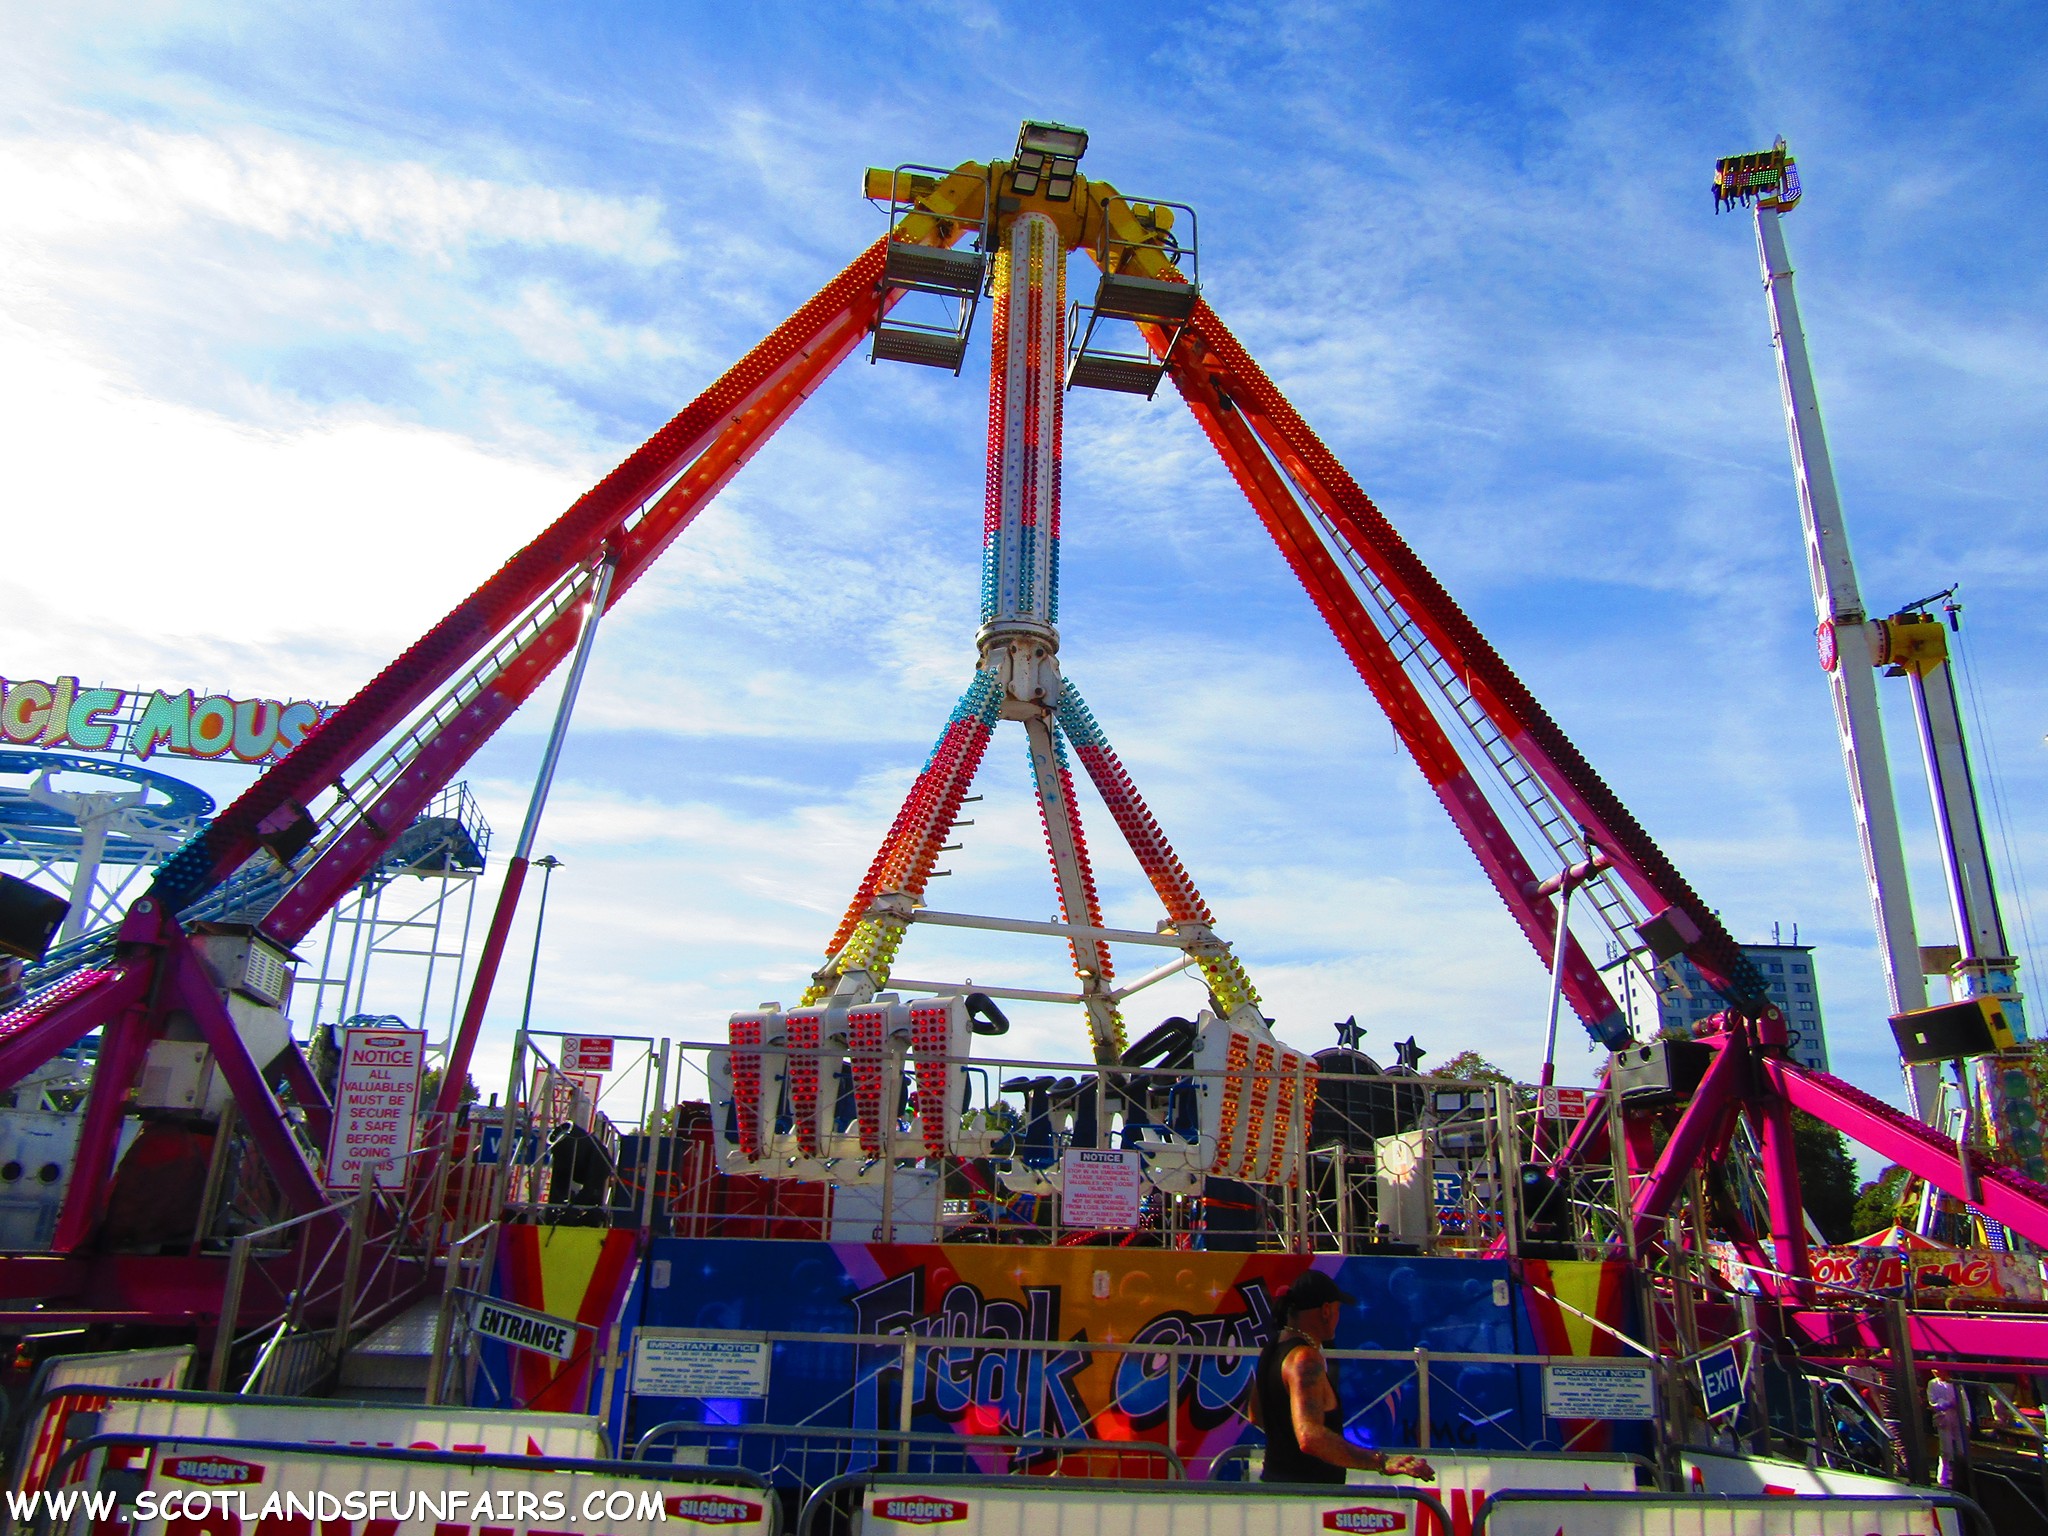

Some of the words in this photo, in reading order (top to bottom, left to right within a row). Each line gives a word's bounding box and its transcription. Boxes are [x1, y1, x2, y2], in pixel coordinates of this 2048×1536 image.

[0, 675, 126, 751] GIC
[129, 688, 340, 764] MOUS
[353, 1050, 413, 1063] NOTICE
[369, 1069, 391, 1080] ALL
[344, 1081, 414, 1093] VALUABLES
[348, 1094, 384, 1105] MUST
[388, 1095, 406, 1106] BE
[350, 1107, 401, 1119] SECURE
[350, 1120, 359, 1131] &
[365, 1120, 398, 1132] SAFE
[346, 1133, 398, 1145] BEFORE
[349, 1146, 391, 1158] GOING
[1083, 1152, 1121, 1162] NOTICE
[342, 1159, 360, 1171] ON
[1868, 1255, 1906, 1290] A
[479, 1306, 567, 1353] ENTRANCE
[649, 1341, 714, 1351] IMPORTANT
[717, 1344, 757, 1353] NOTICE
[1554, 1367, 1608, 1377] IMPORTANT
[1611, 1370, 1643, 1378] NOTICE
[1705, 1364, 1735, 1398] EXIT
[177, 1460, 249, 1480] SILCOCK'S
[679, 1500, 748, 1519] SILCOCK'S
[887, 1501, 954, 1518] SILCOCK'S
[1335, 1513, 1394, 1528] SILCOCK'S
